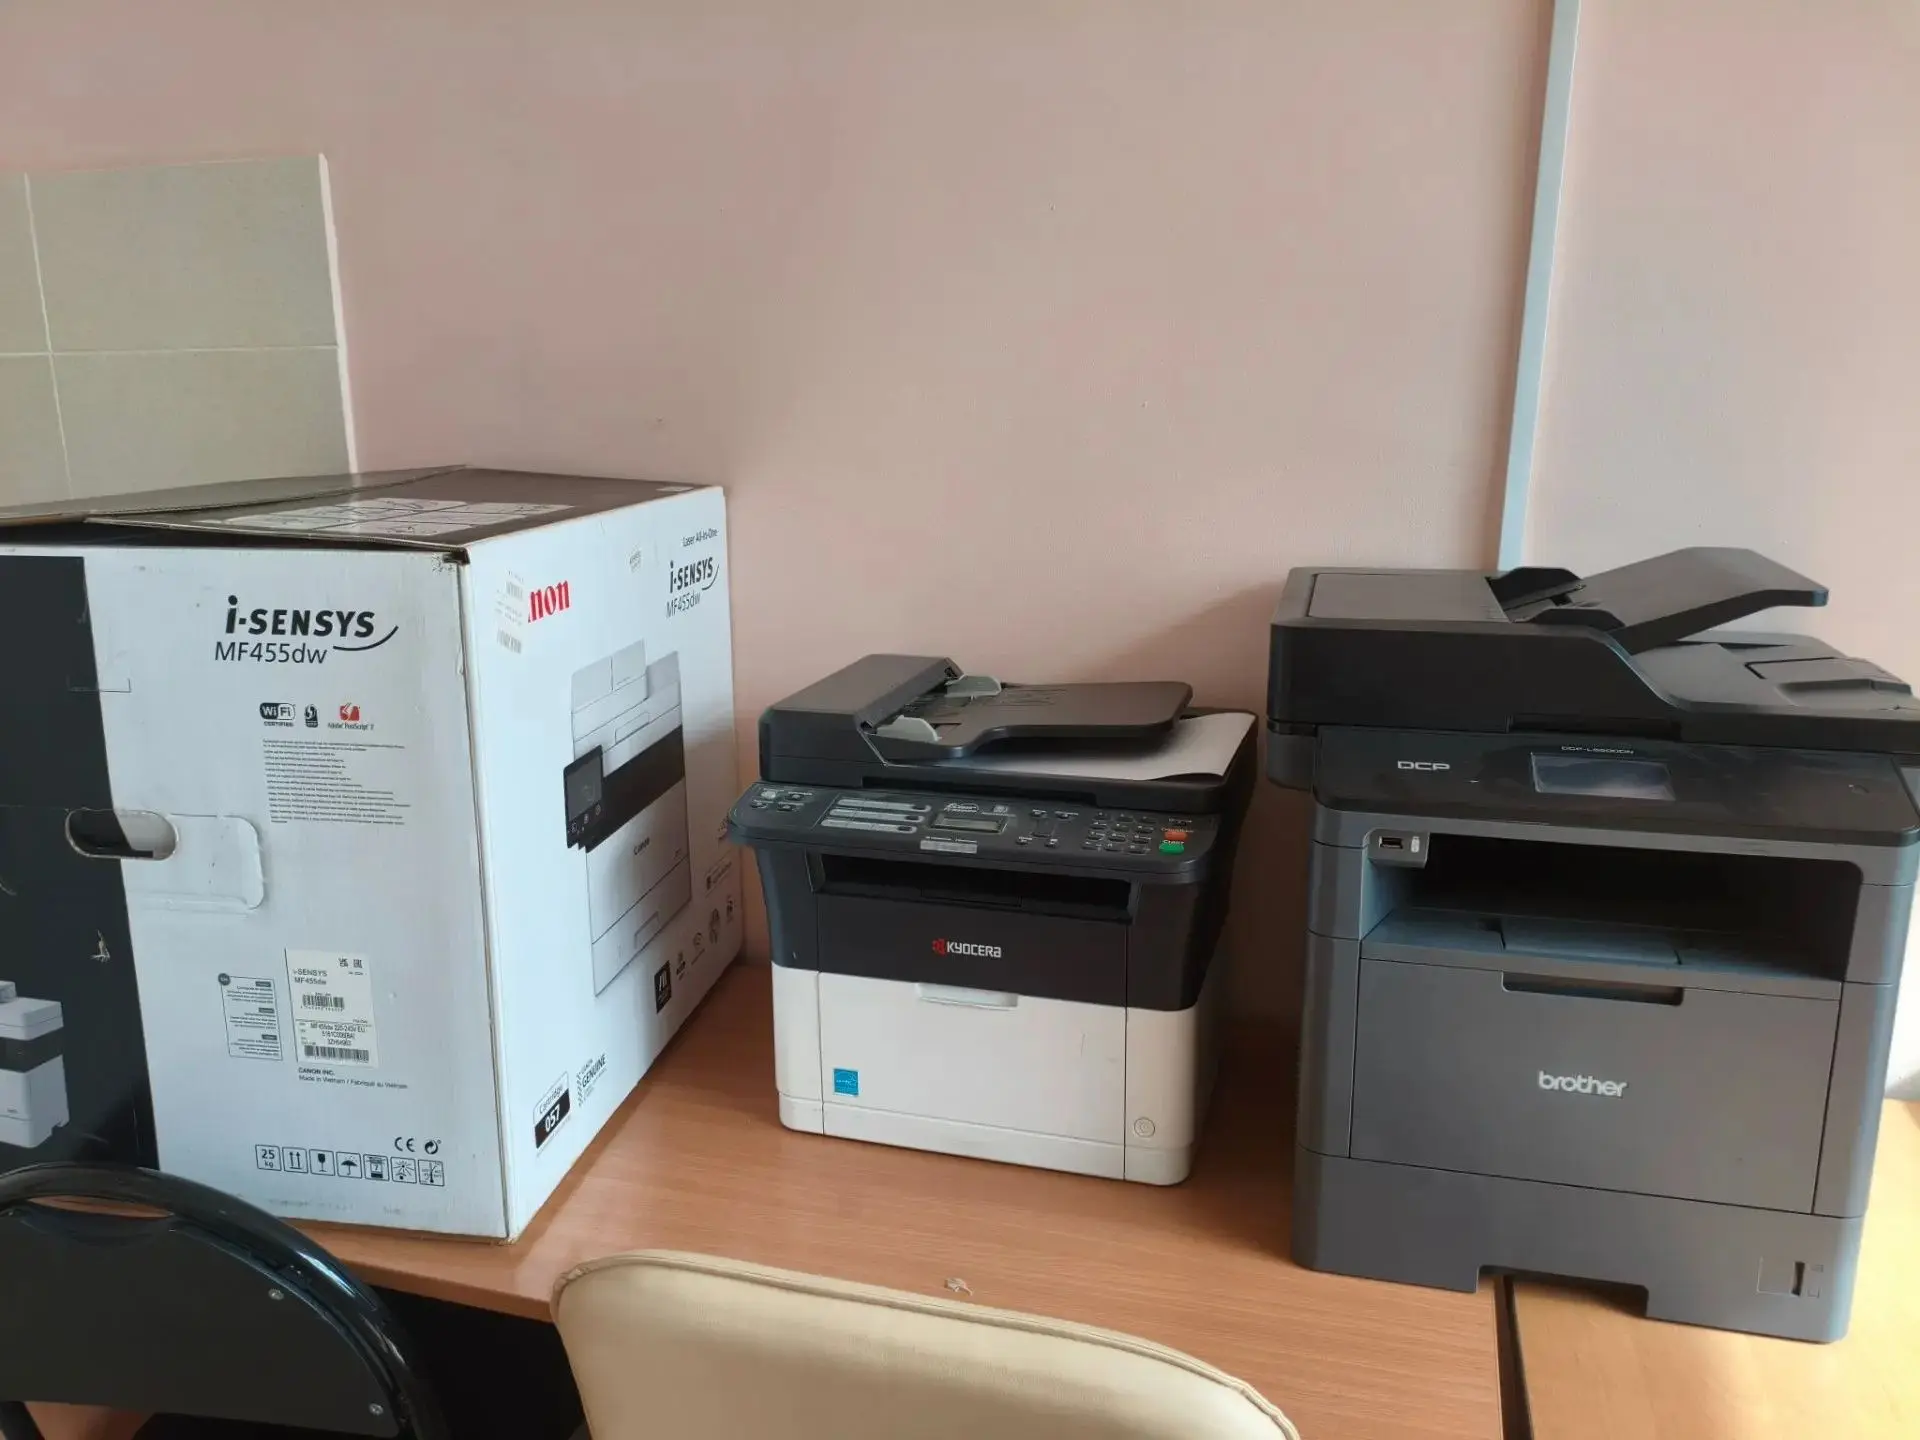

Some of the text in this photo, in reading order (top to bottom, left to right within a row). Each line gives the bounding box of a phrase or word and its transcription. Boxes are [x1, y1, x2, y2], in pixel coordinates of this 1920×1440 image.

[670, 556, 714, 593] i-SENSYS
[528, 580, 570, 623] non
[666, 590, 701, 619] MF455dw
[225, 594, 376, 638] i-SENSYS
[214, 641, 328, 664] MF455dw
[1397, 760, 1450, 771] DCP
[1538, 1070, 1628, 1097] brother
[545, 1103, 560, 1133] 057
[261, 1148, 275, 1160] 25
[264, 1160, 274, 1169] kg
